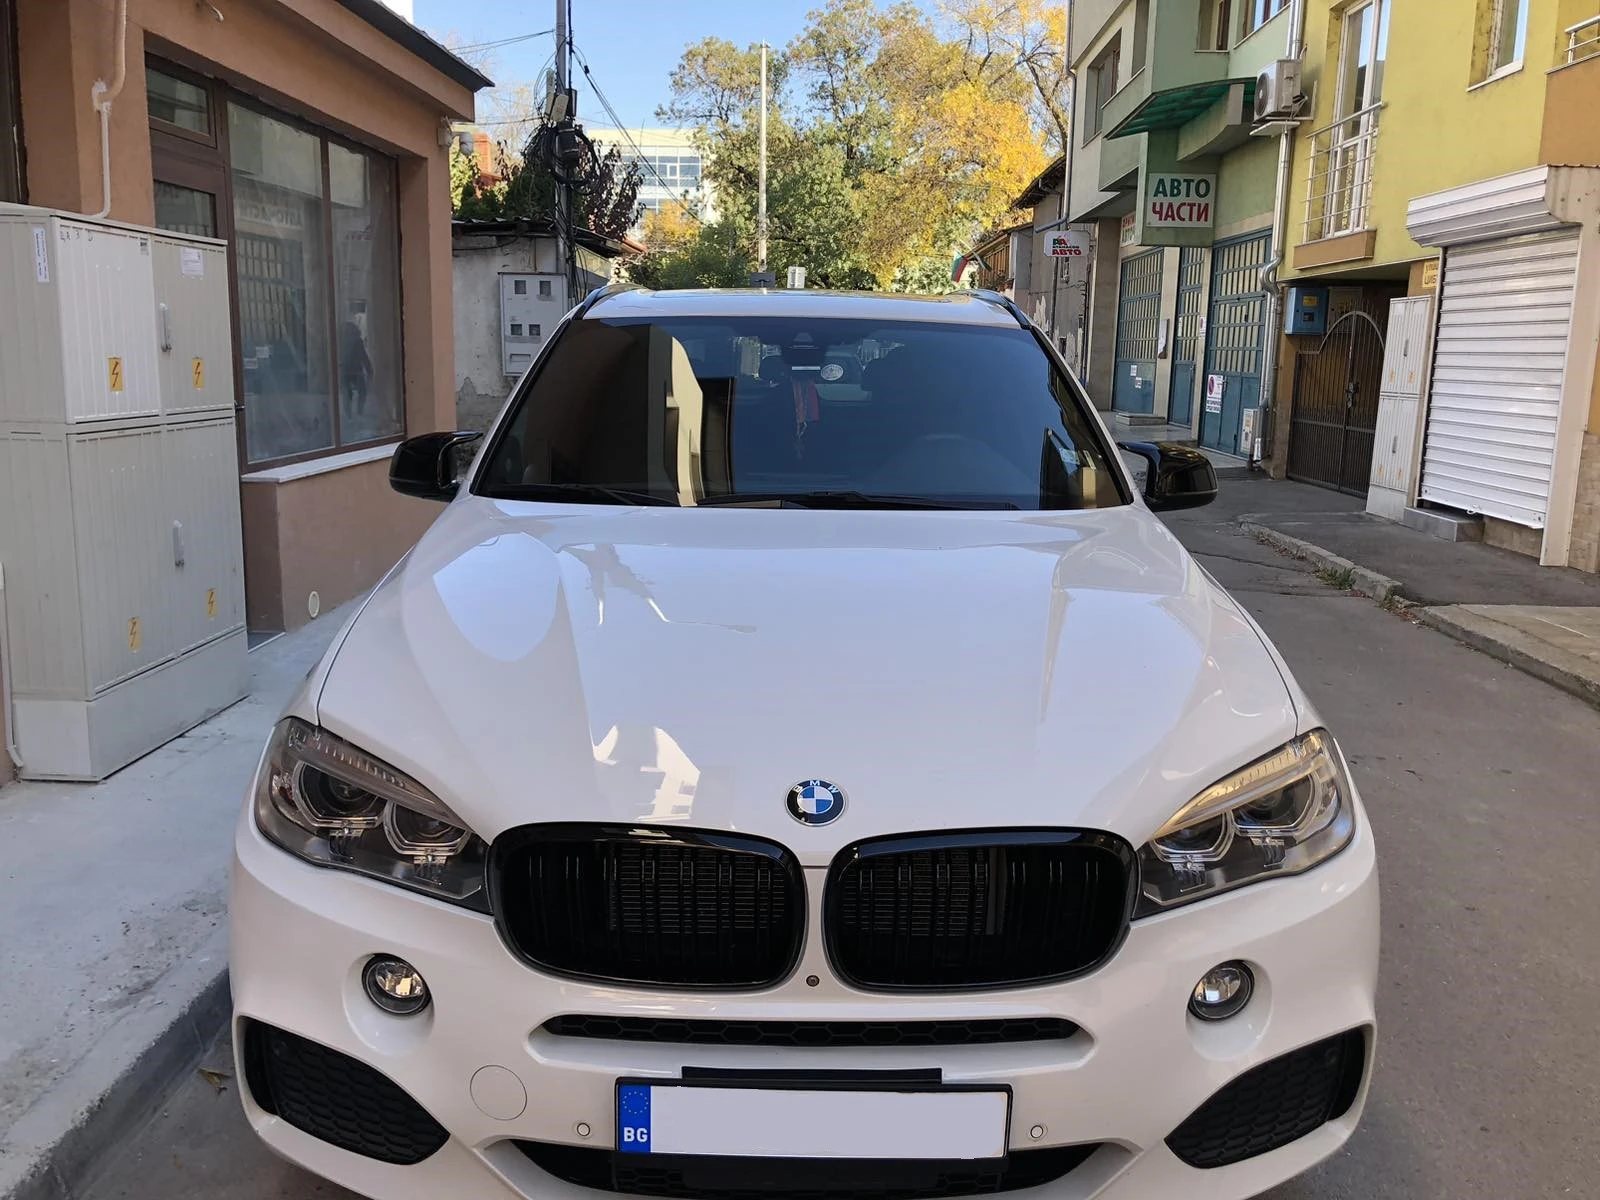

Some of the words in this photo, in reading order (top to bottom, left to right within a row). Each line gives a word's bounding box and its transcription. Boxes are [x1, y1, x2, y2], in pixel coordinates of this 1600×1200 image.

[1153, 178, 1211, 198] АВТО
[1152, 202, 1209, 222] ЧАСТИ
[793, 779, 840, 794] BMW
[623, 1127, 648, 1142] BG
